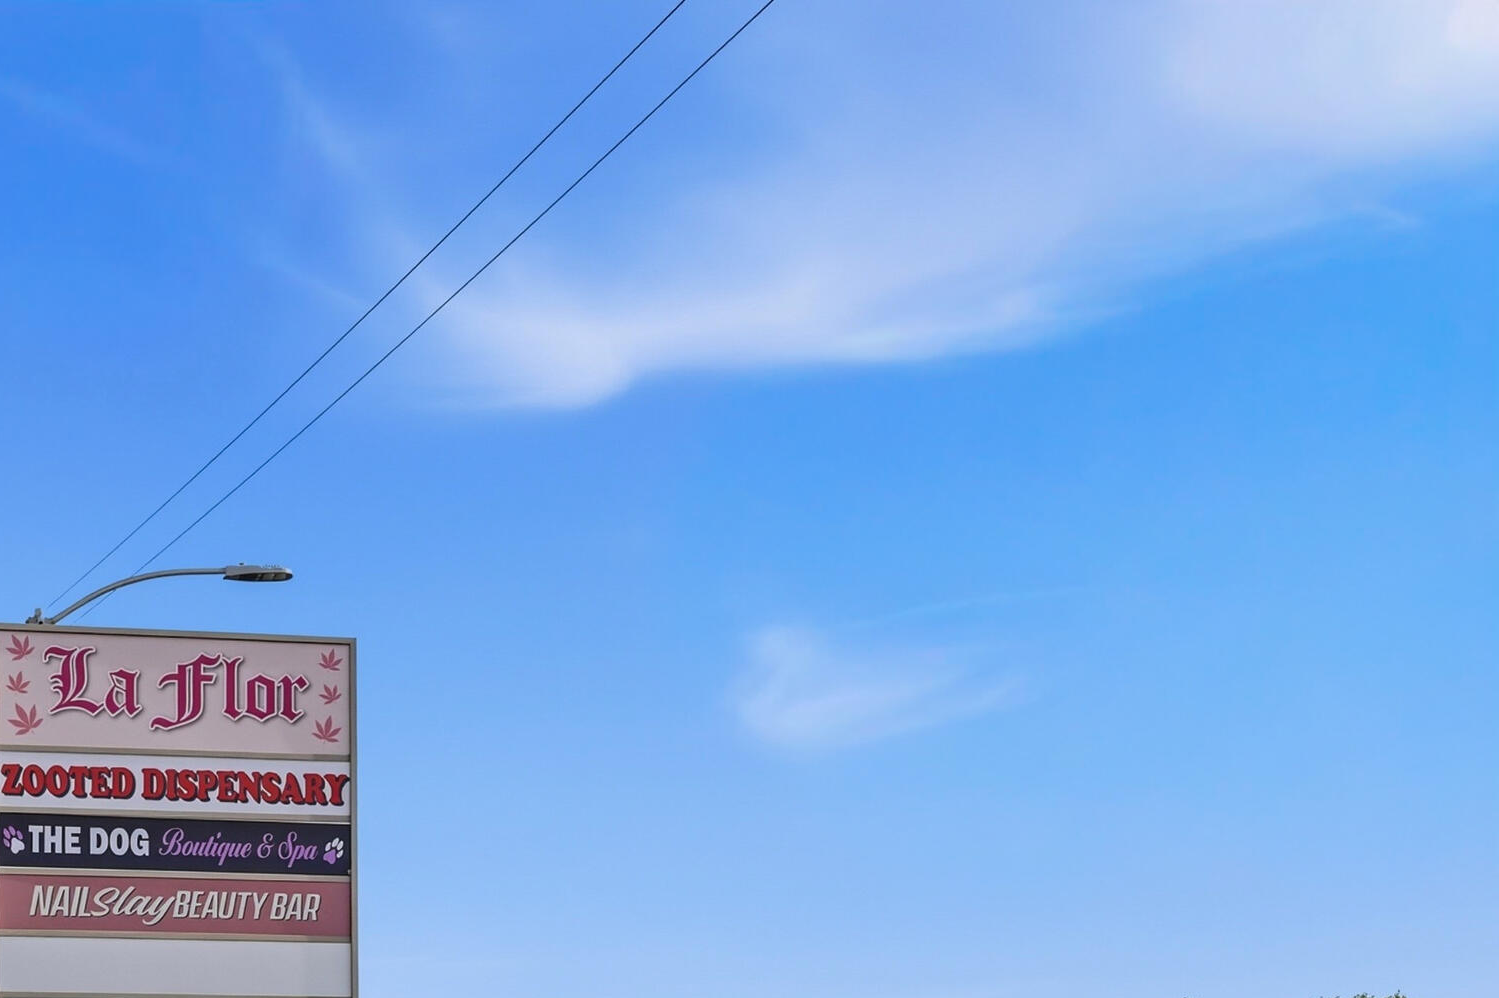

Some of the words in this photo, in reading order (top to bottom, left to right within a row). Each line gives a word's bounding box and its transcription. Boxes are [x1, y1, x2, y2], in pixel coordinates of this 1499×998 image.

[43, 645, 142, 718] La
[149, 652, 309, 732] Flor
[1, 763, 135, 800] ZOOTED
[141, 768, 350, 806] DISPENSARY
[28, 825, 81, 854] THE
[90, 827, 149, 856] DOG
[158, 828, 252, 865] Boutique
[257, 833, 274, 858] &
[278, 832, 318, 868] Spa
[172, 890, 270, 920] BEAUTY
[269, 893, 321, 920] BAR
